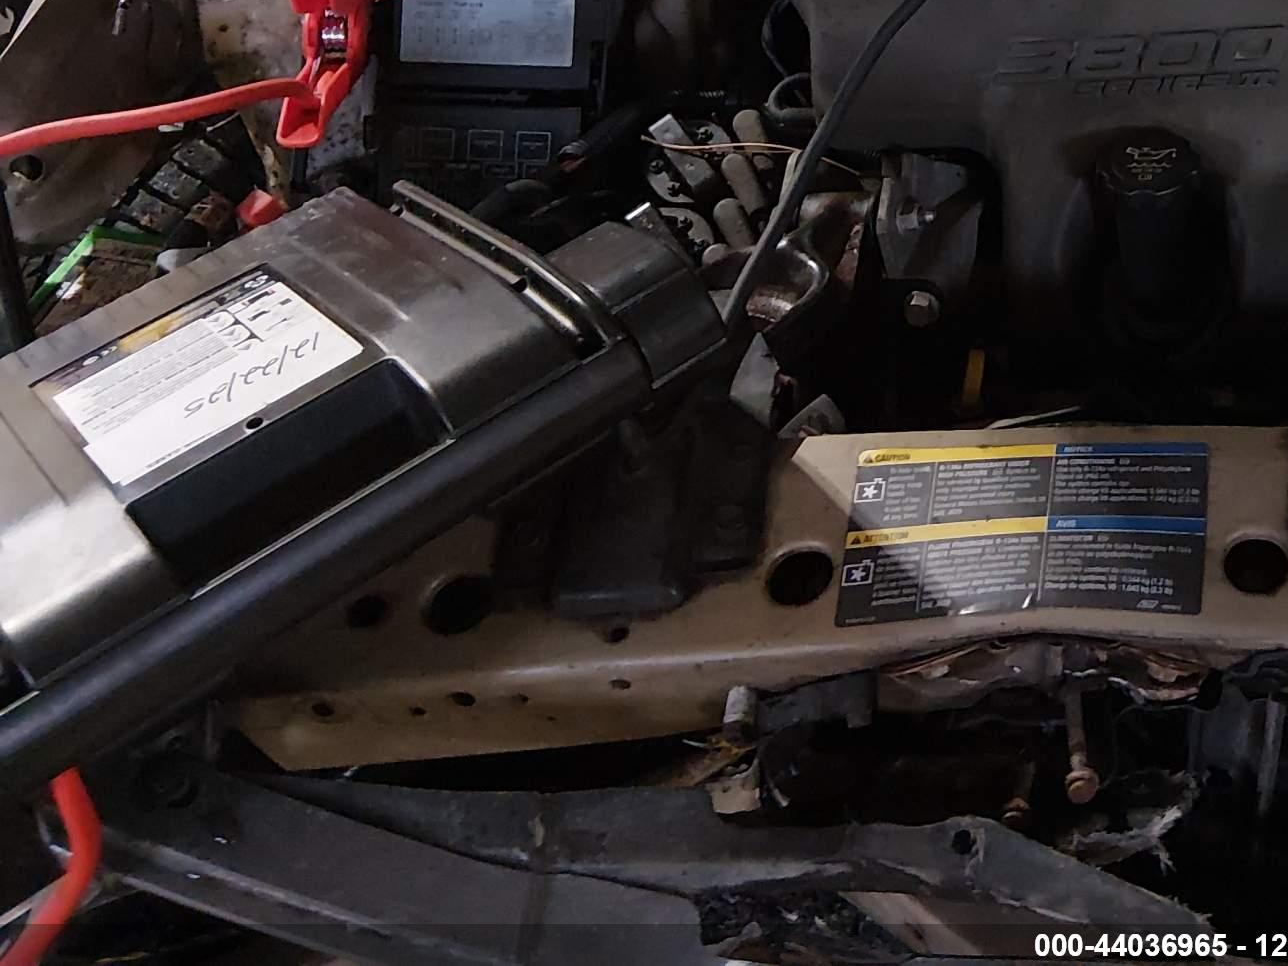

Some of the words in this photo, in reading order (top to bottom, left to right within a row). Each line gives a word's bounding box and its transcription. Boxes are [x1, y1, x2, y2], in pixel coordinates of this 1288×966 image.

[184, 331, 321, 419] 12/22/25
[875, 453, 912, 463] CAUTION
[1055, 519, 1077, 528] AVIS
[863, 531, 910, 544] ATTENTION
